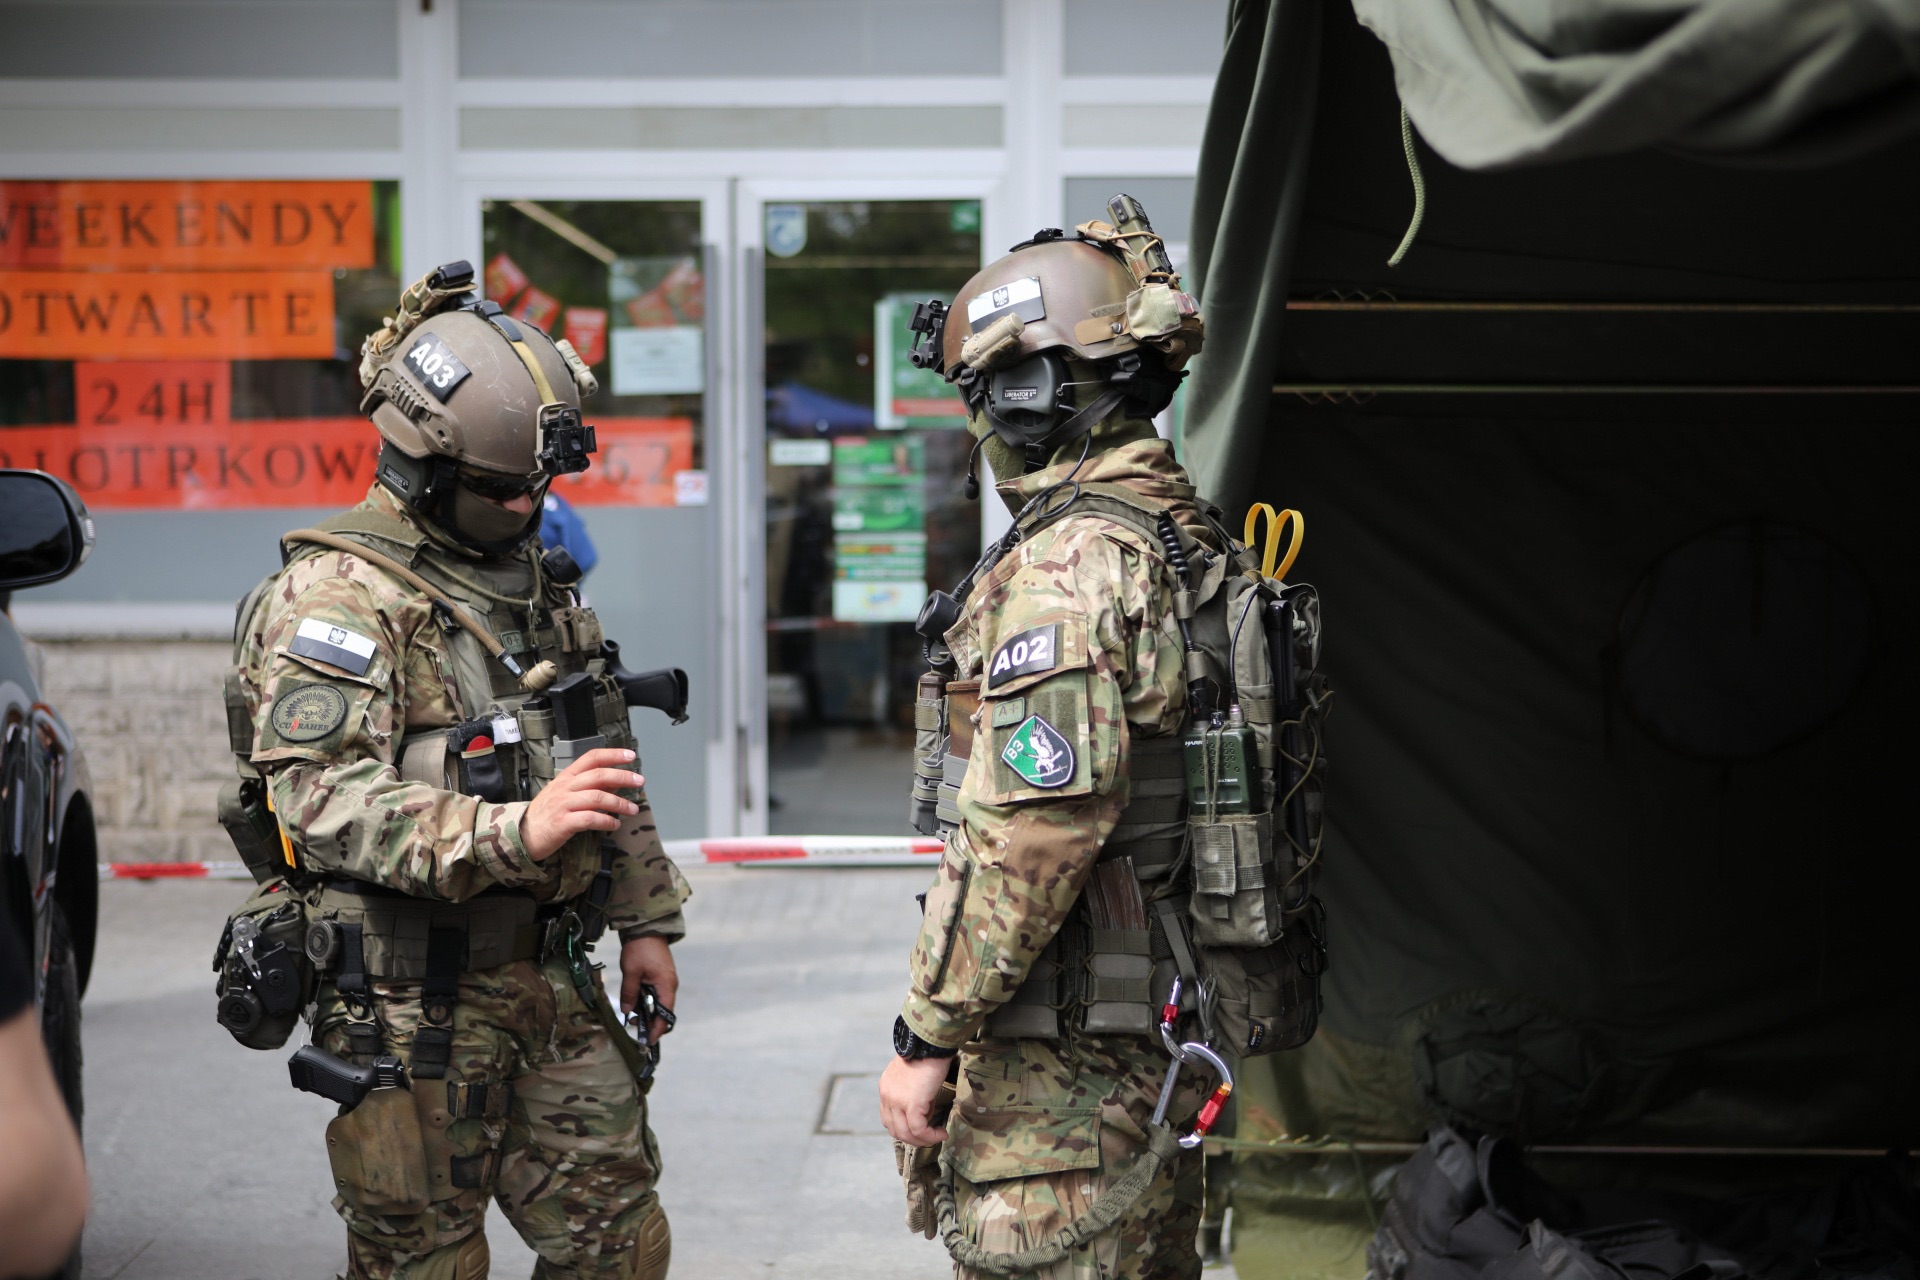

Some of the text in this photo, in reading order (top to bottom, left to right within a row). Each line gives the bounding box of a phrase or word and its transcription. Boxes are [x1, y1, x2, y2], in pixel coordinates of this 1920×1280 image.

[408, 341, 456, 389] A03
[92, 379, 215, 425] 24H
[0, 442, 380, 491] OTRKOW
[992, 636, 1048, 676] A02
[279, 722, 330, 731] CURAHEE
[999, 704, 1018, 717] A+
[1006, 739, 1024, 760] B3
